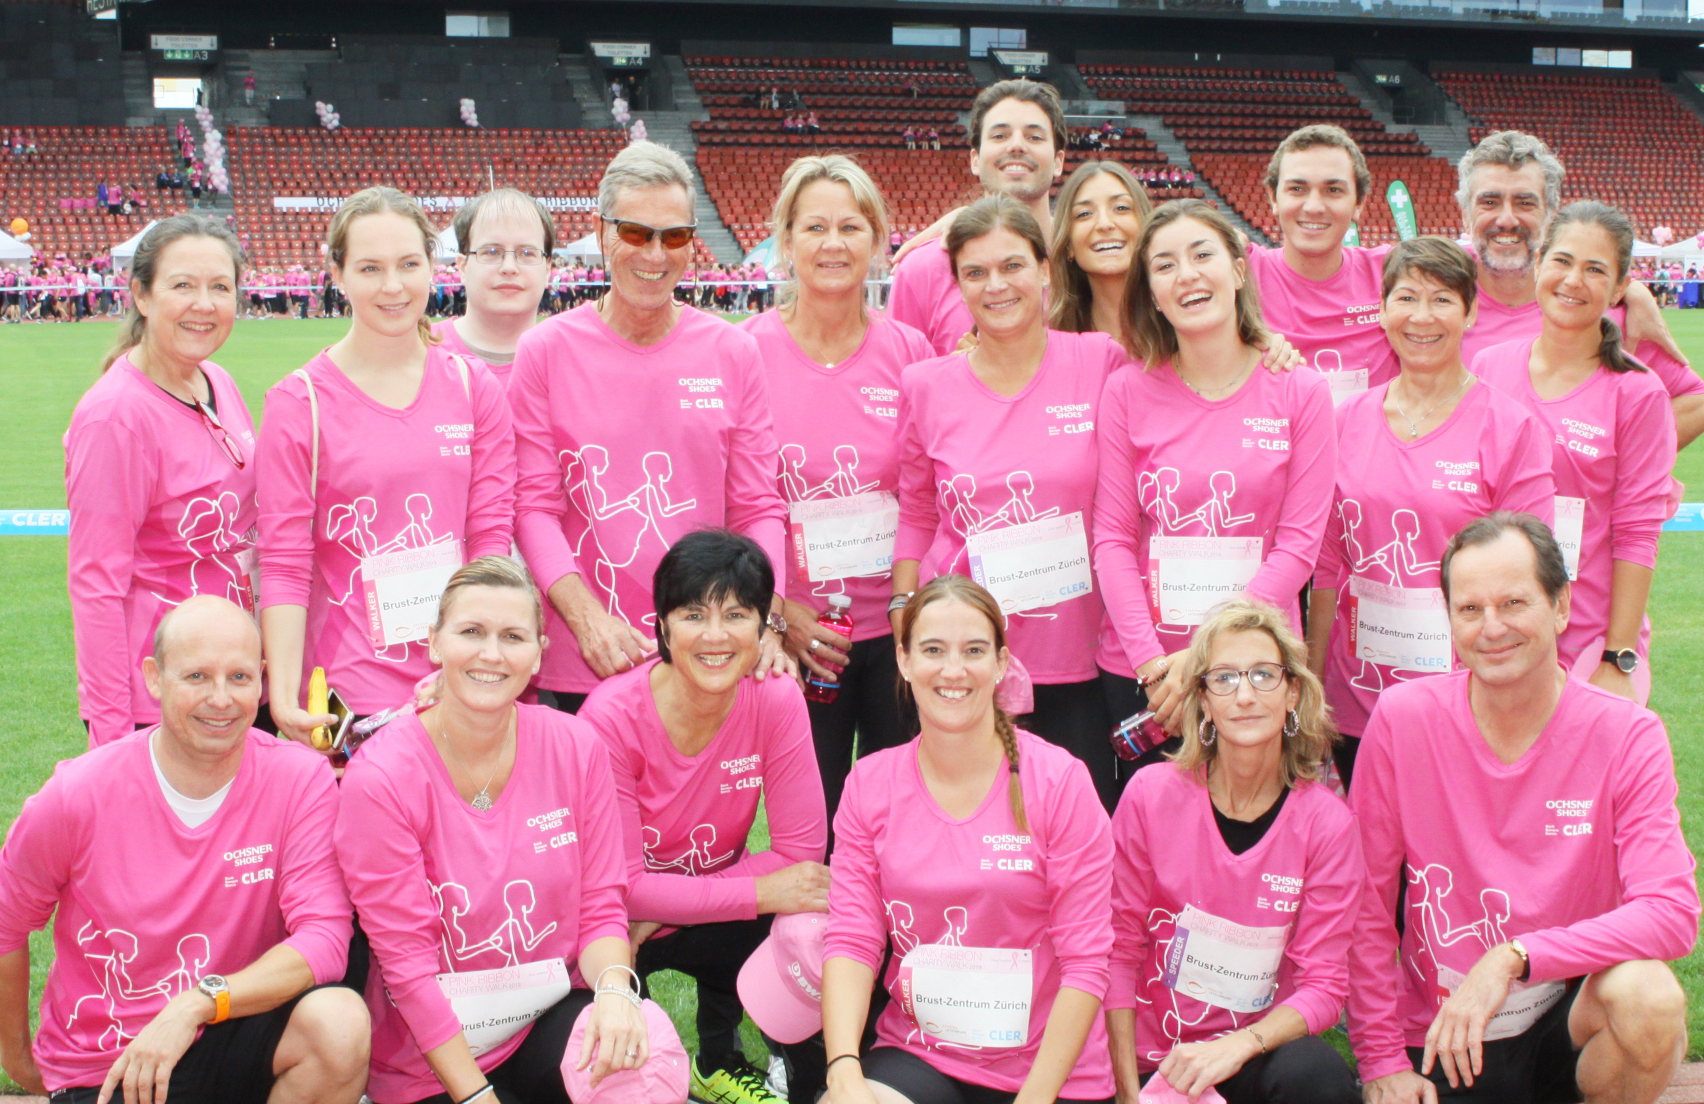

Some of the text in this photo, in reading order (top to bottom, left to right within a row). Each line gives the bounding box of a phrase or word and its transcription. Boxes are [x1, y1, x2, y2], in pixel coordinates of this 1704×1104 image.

[194, 51, 208, 60] A3
[629, 57, 643, 66] A4
[1028, 66, 1041, 74] A5
[1388, 75, 1400, 84] A6
[1346, 304, 1380, 314] OCHSNE
[678, 378, 723, 386] OCHSNER
[860, 386, 899, 397] OCHSNER
[869, 394, 894, 402] SHOES
[695, 398, 724, 409] CLER
[1046, 403, 1091, 414] OCHSNER
[875, 407, 898, 418] CLE
[434, 424, 475, 434] OCHSNER
[1064, 421, 1095, 434] CLER
[1243, 418, 1290, 427] OCHSNER
[1561, 418, 1606, 436] OCHSNER
[1252, 426, 1280, 434] SHOES
[1568, 426, 1594, 440] SHOES
[1258, 438, 1290, 450] CLER
[1568, 440, 1599, 458] CLER
[1435, 460, 1480, 471] OCHSNER
[1448, 481, 1478, 494] CLER
[800, 502, 824, 512] PINK
[825, 498, 862, 510] RIBBON
[12, 512, 66, 526] CLER
[800, 511, 830, 520] CHARITY
[830, 510, 851, 518] WALK
[978, 532, 1000, 546] PINK
[1002, 524, 1042, 540] RIBBON
[794, 532, 806, 568] WALKER
[808, 535, 874, 552] Brust-Zentrum
[978, 541, 1008, 552] CHARITY
[1010, 536, 1031, 548] WALK
[1160, 540, 1180, 550] PINK
[1182, 540, 1222, 550] RIBBON
[1558, 540, 1577, 550] rich
[372, 556, 396, 570] PINK
[397, 550, 436, 565] RIBBON
[1159, 550, 1187, 558] CHARITY
[875, 556, 893, 567] CLE
[372, 564, 404, 577] CHARITY
[404, 561, 427, 573] WALK
[989, 556, 1086, 585] Brust-Zentrum Zürich
[1060, 581, 1087, 597] CLER
[1162, 582, 1230, 592] Brust-Zentrum
[368, 591, 380, 632] WALKER
[1359, 620, 1448, 641] Brust-Zentrum Zürich
[1414, 656, 1444, 667] CLER
[720, 754, 761, 770] OCHSNER
[730, 762, 756, 776] SHOES
[1556, 808, 1587, 816] SHOES
[1562, 822, 1592, 836] CLER
[550, 832, 578, 849] CLER
[983, 834, 1032, 844] OCHSNER
[223, 844, 274, 862] OCHSNER
[234, 854, 264, 867] SHOES
[998, 858, 1034, 871] CLER
[242, 868, 275, 884] CLER
[1261, 873, 1304, 888] OCHSNE
[1270, 884, 1301, 894] SHOES
[1192, 912, 1261, 940] PINK RIBBON
[1190, 922, 1222, 940] CHARITY
[1224, 934, 1246, 946] WALK
[915, 948, 938, 959] PINK
[940, 948, 982, 962] RIBBON
[1169, 936, 1185, 975] SPEEDER
[912, 958, 946, 968] CHARITY
[947, 960, 968, 970] WALK
[1186, 954, 1258, 981] Brust-Zentrum
[449, 969, 522, 987] PINK RIBBON
[449, 984, 484, 996] CHARITY
[485, 982, 508, 993] WALK
[916, 994, 1028, 1010] Brust-Zentrum Zürich
[989, 1030, 1022, 1042] CLER
